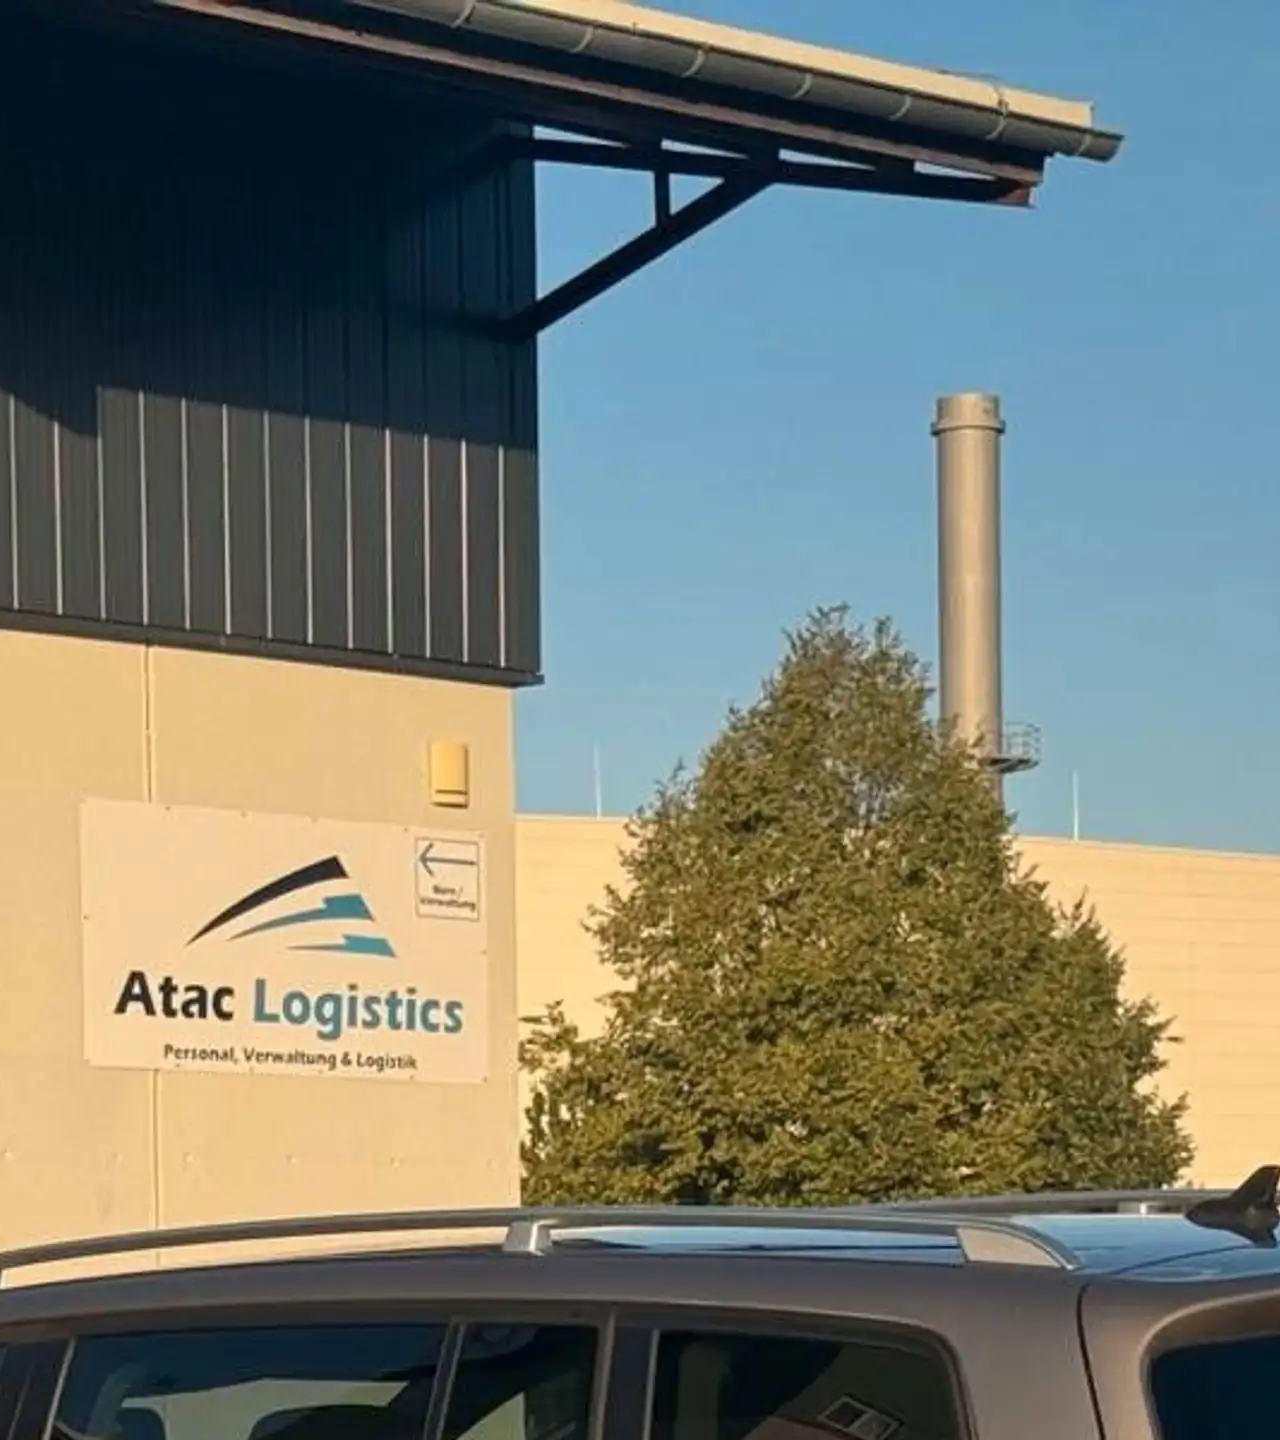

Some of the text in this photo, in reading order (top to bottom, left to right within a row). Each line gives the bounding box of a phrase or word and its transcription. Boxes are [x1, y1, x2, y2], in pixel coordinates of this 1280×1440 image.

[114, 970, 464, 1041] Atac Logistics
[163, 1043, 418, 1072] Personal, Verwaltung & Logistik
